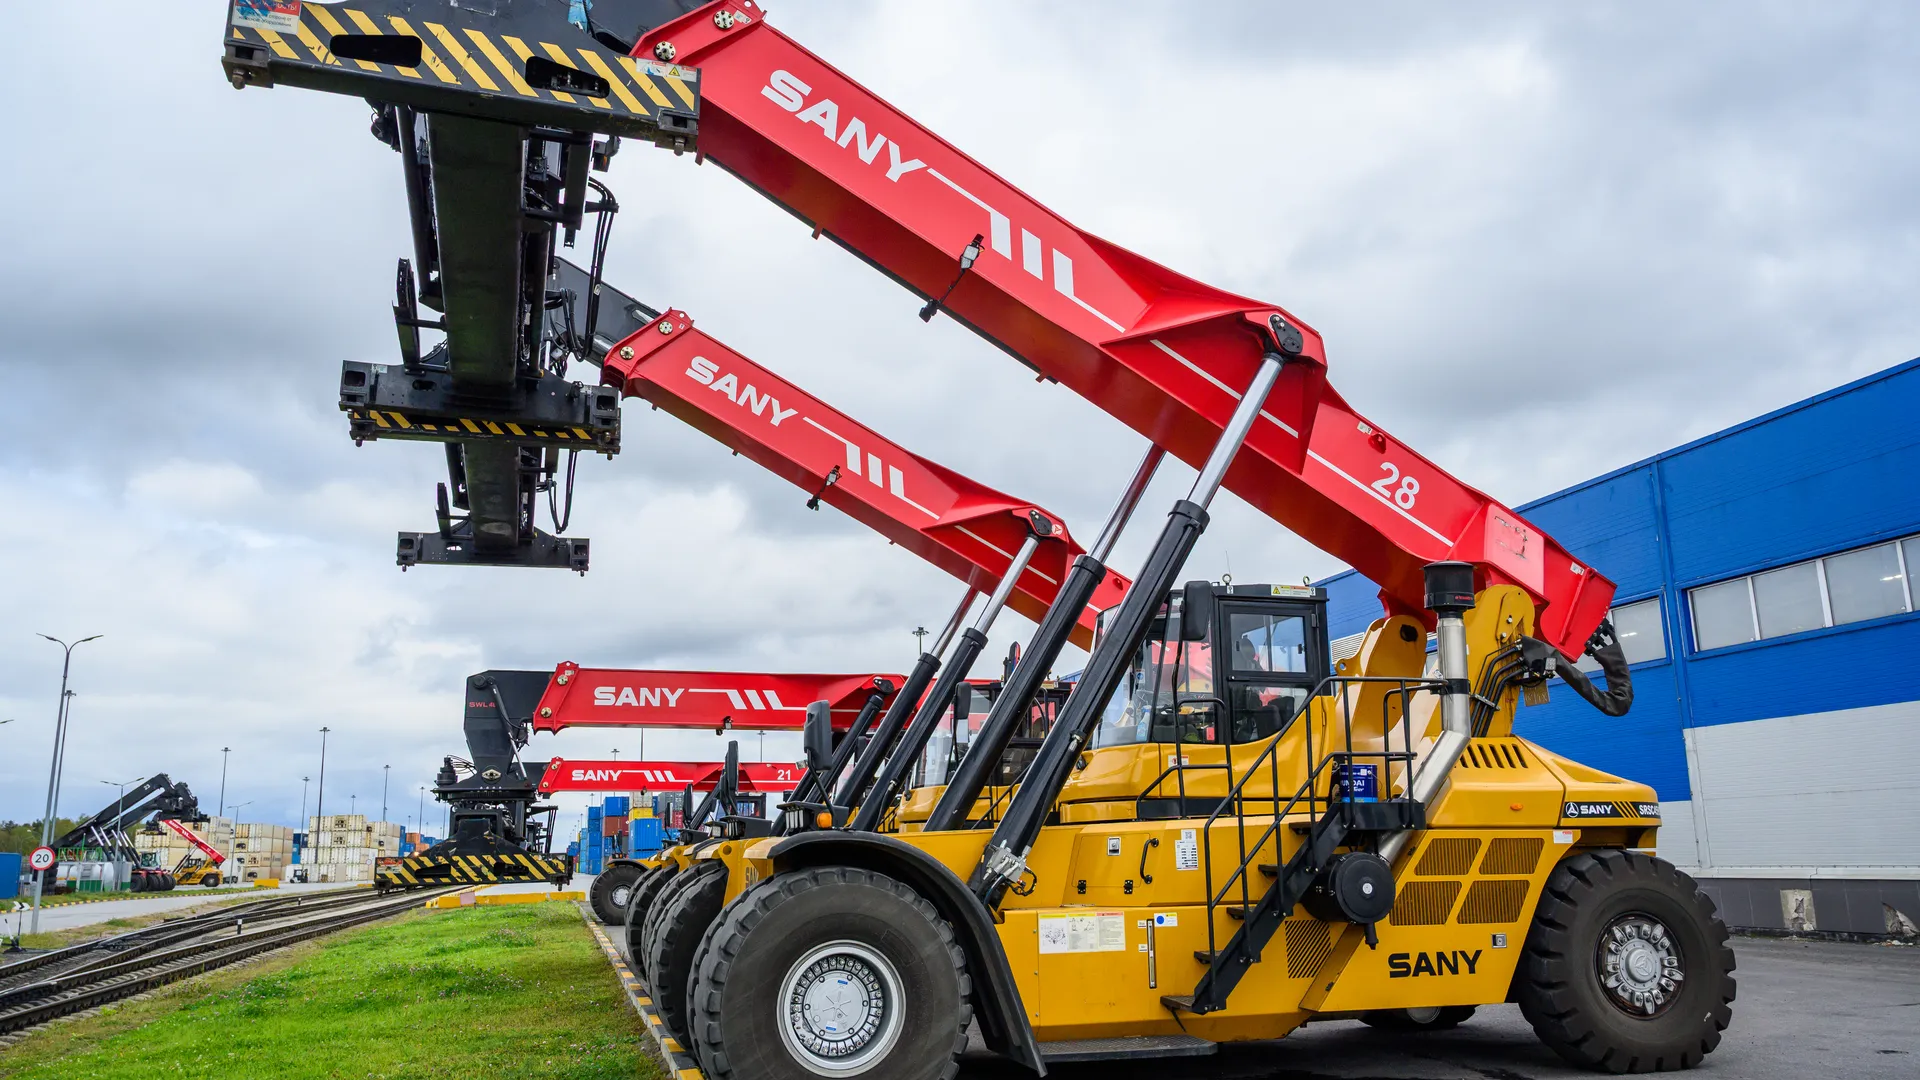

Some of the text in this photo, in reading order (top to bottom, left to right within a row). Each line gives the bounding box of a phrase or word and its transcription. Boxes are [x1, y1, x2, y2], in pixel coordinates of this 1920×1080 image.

[760, 69, 928, 183] SANY
[684, 355, 799, 427] SANY
[1370, 461, 1420, 511] 28
[593, 686, 685, 708] SANY
[571, 769, 622, 782] SANY
[777, 769, 791, 781] 21
[1580, 804, 1613, 815] SANY
[35, 853, 50, 863] 20
[1387, 949, 1483, 979] SANY
